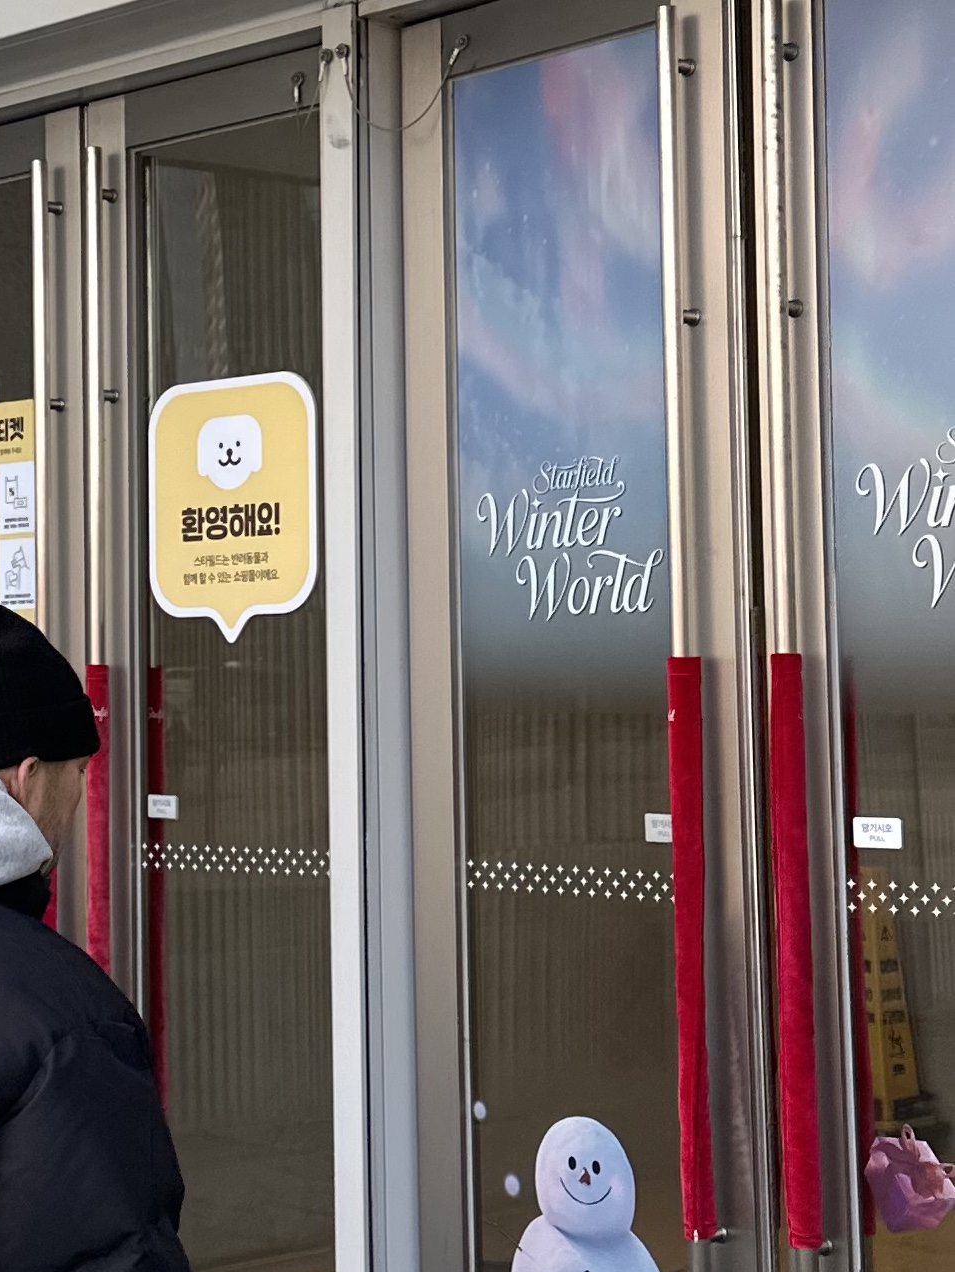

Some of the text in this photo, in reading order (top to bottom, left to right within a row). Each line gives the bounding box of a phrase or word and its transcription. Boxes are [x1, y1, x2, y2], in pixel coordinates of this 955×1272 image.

[533, 455, 621, 495] Starfield
[181, 502, 281, 542] 환영해요!
[477, 480, 626, 558] Winter
[193, 554, 230, 567] 스타필드는
[516, 548, 665, 622] World
